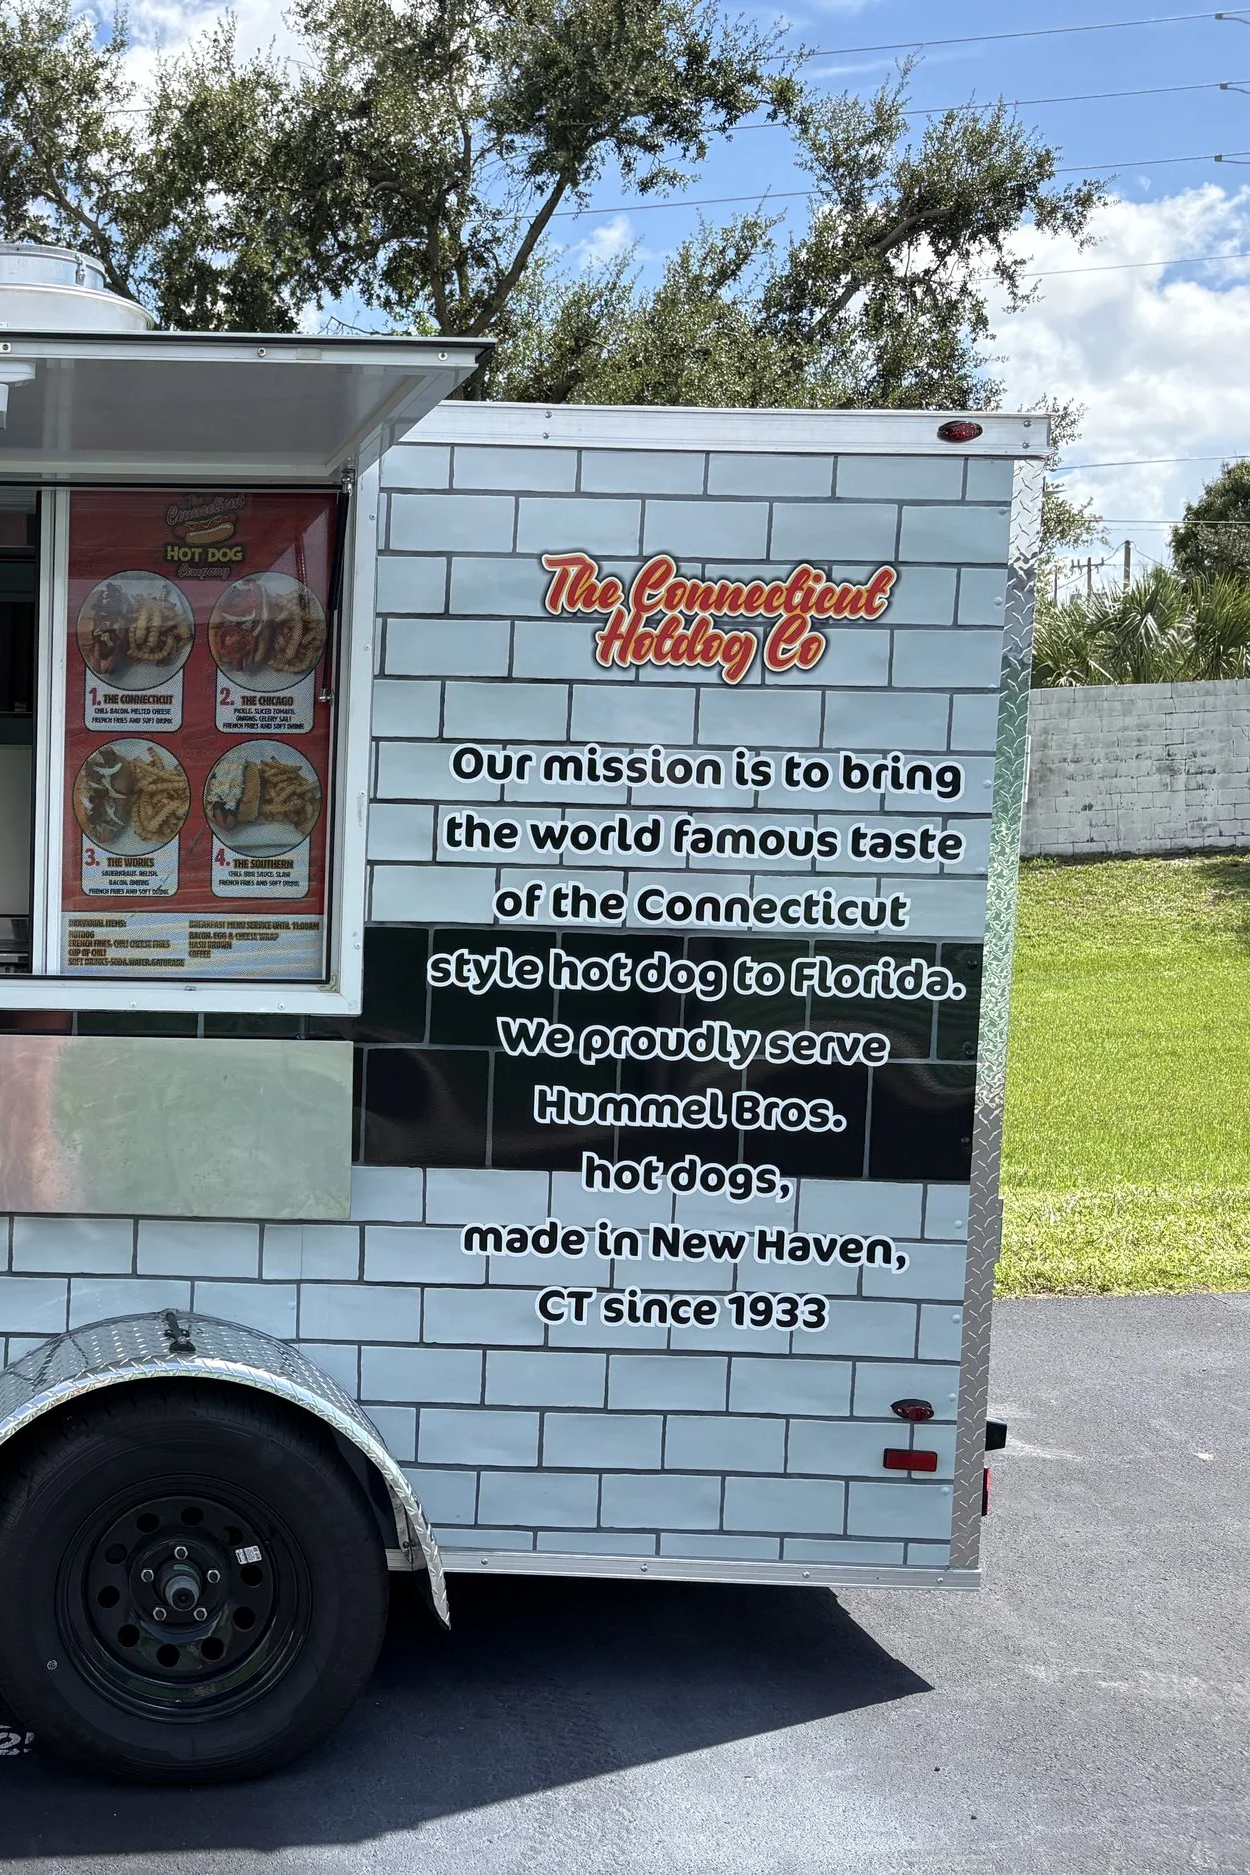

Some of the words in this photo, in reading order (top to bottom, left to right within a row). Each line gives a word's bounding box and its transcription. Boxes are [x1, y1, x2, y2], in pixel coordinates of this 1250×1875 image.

[166, 545, 203, 562] HOT
[207, 546, 243, 562] DOG
[177, 563, 231, 581] Company
[541, 553, 622, 615] The
[632, 555, 897, 620] Connecticut
[596, 610, 757, 685] Hotdog
[764, 613, 827, 671] Co
[88, 687, 101, 706] 1.
[103, 694, 119, 704] THE
[120, 694, 173, 705] CONNECTICUT
[220, 687, 235, 706] 2.
[241, 696, 257, 706] THE
[258, 696, 294, 706] CHICAGO
[451, 746, 532, 782] Our
[543, 747, 722, 787] mission
[735, 749, 773, 788] is
[784, 756, 830, 790] to
[843, 753, 963, 799] bring
[84, 848, 100, 867] 3.
[107, 858, 123, 867] THE
[124, 858, 154, 868] WORKS
[215, 848, 231, 867] 4.
[233, 859, 249, 869] THE
[250, 859, 294, 869] SOUTHERN
[445, 814, 518, 850] the
[530, 819, 661, 854] world
[673, 819, 838, 860] famous
[851, 824, 964, 861] taste
[494, 883, 542, 918] of
[552, 885, 625, 920] the
[636, 888, 909, 929] Connecticut
[428, 950, 541, 993] style
[550, 953, 632, 990] hot
[638, 953, 726, 1000] dog
[735, 958, 783, 994] to
[792, 958, 966, 1000] Florida.
[498, 1017, 571, 1056] We
[581, 1022, 761, 1068] proudly
[766, 1031, 889, 1065] serve
[534, 1087, 726, 1129] Hummel
[734, 1093, 847, 1132] Bros.
[583, 1155, 663, 1193] hot
[671, 1157, 792, 1201] dogs,
[463, 1222, 587, 1256] made
[597, 1220, 639, 1259] in
[651, 1228, 746, 1260] New
[756, 1231, 908, 1272] Haven,
[537, 1290, 594, 1324] CT
[603, 1289, 716, 1326] since
[728, 1295, 828, 1330] 1933
